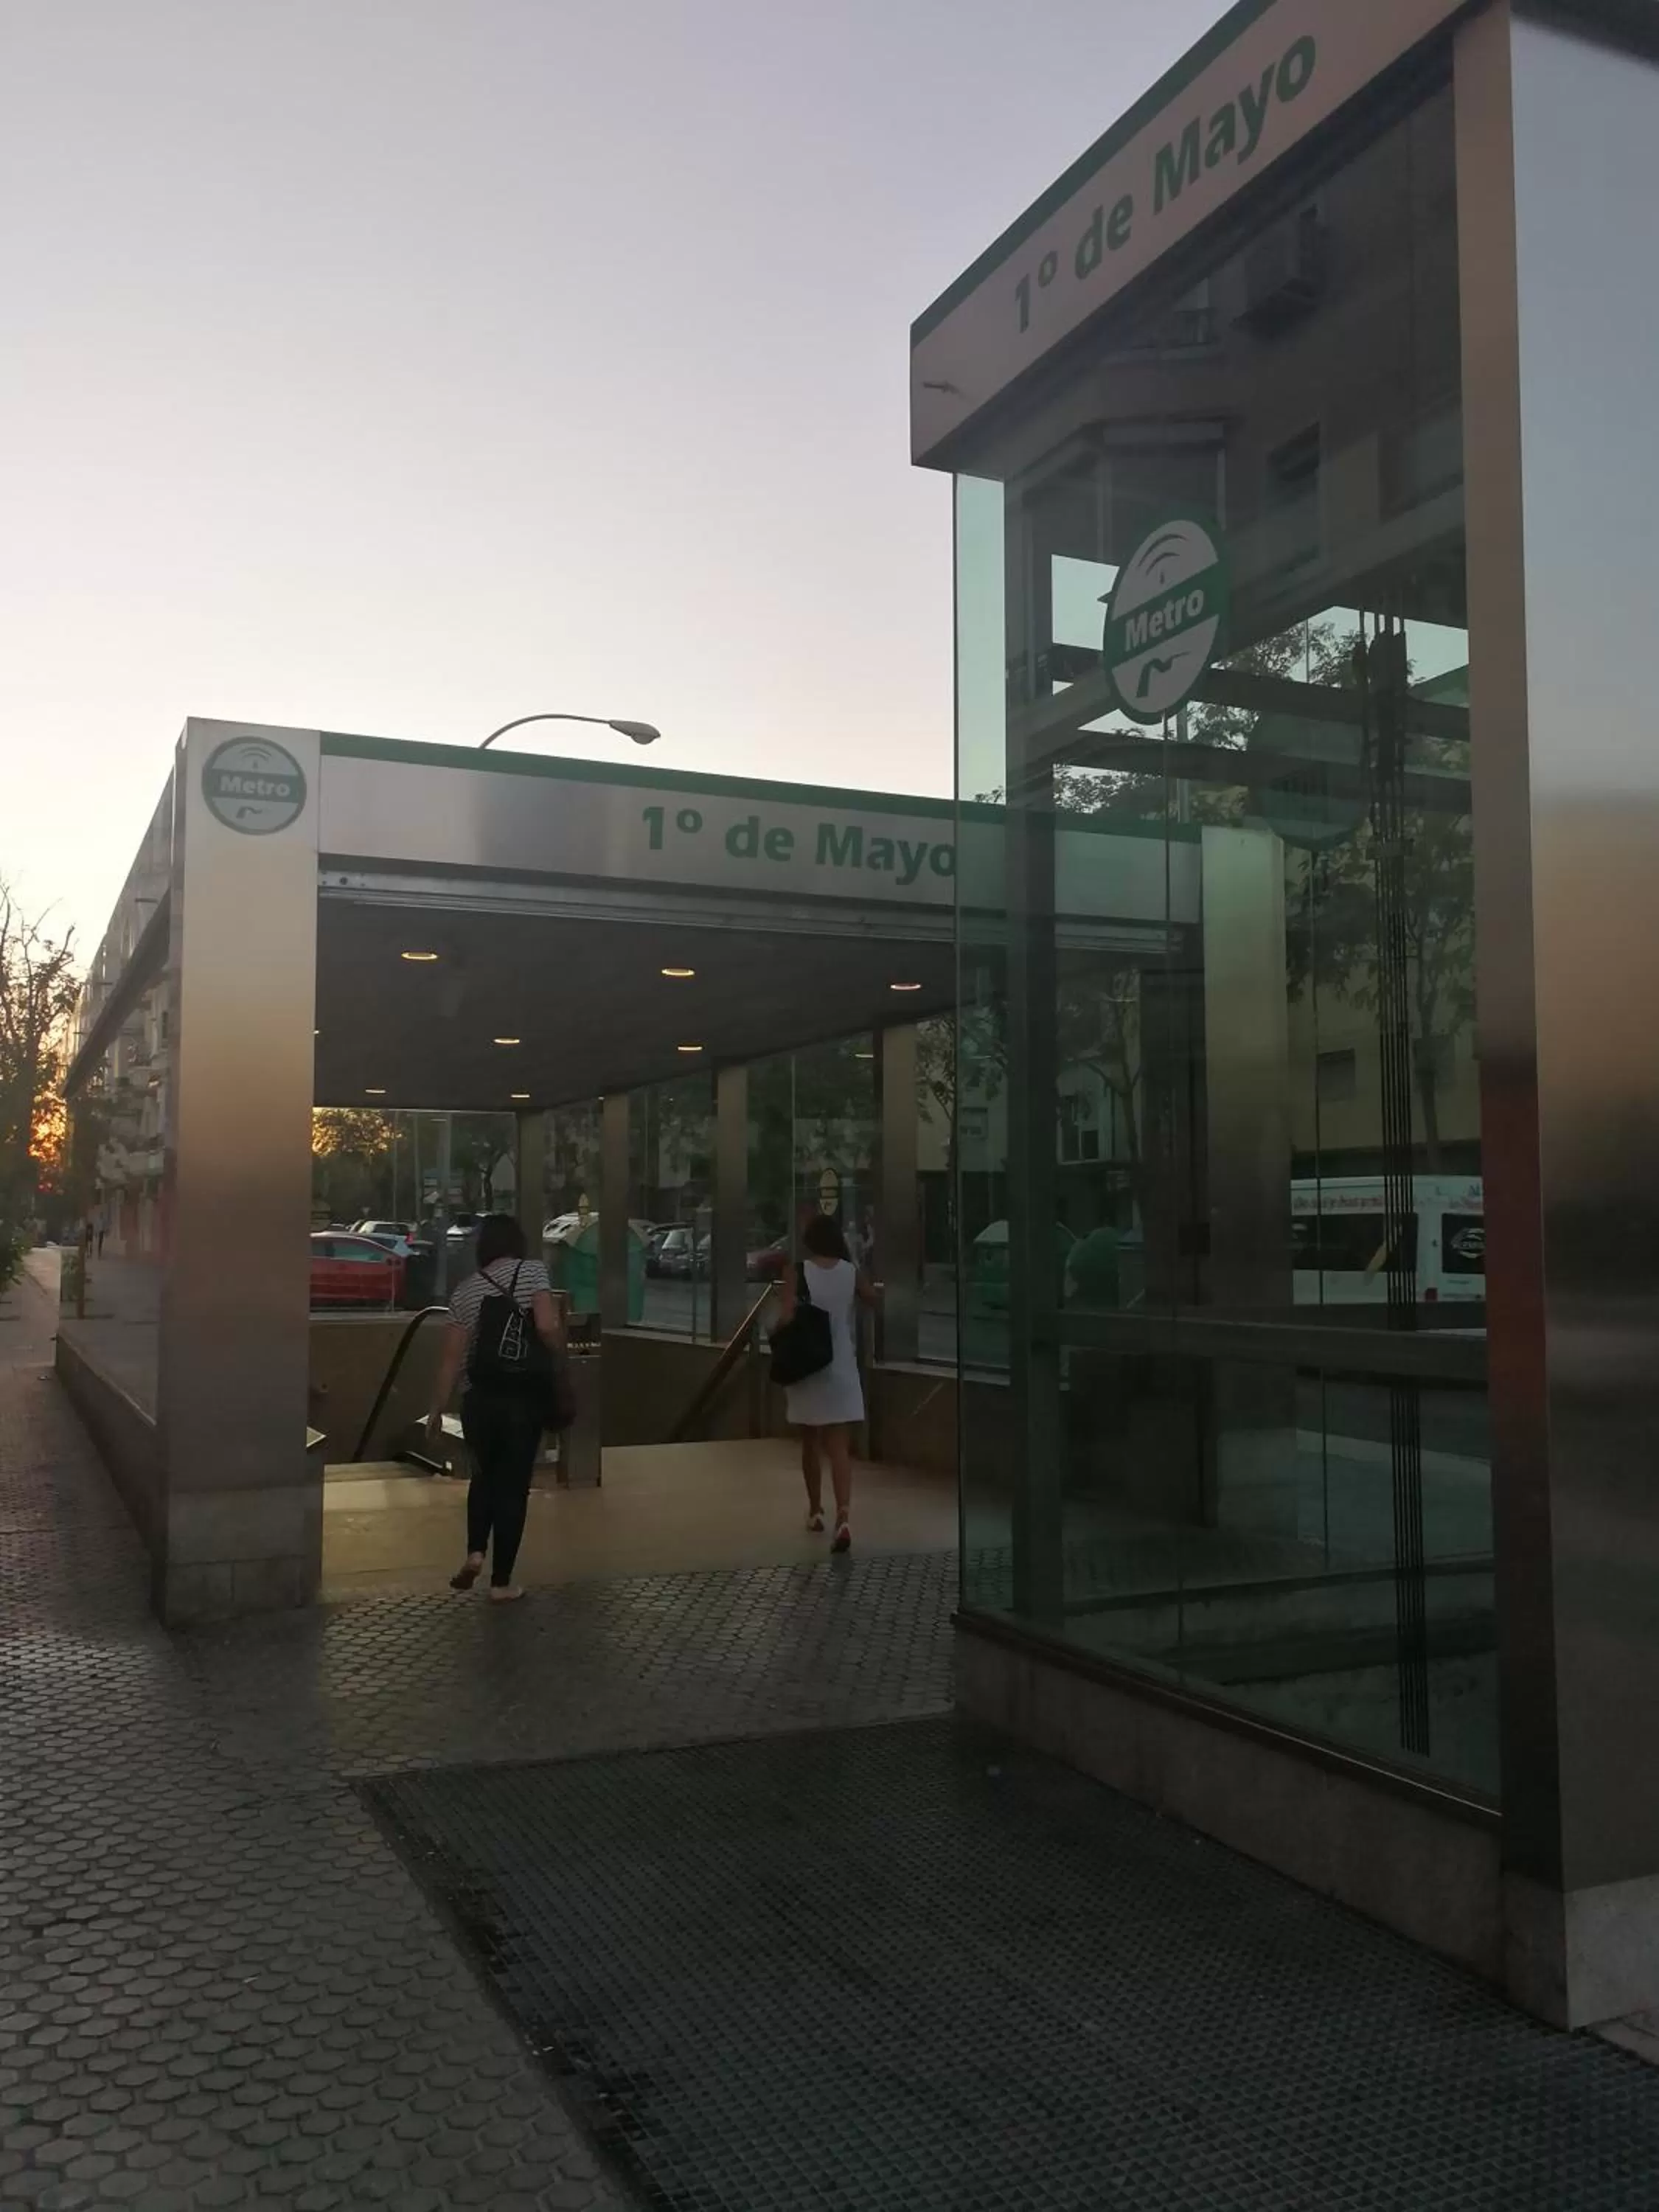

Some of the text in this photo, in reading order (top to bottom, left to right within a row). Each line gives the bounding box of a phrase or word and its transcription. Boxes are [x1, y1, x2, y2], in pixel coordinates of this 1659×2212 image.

[1074, 193, 1133, 281] de
[1152, 35, 1316, 216] Mayo
[1124, 589, 1205, 653] Metro
[220, 776, 291, 797] Metro
[725, 815, 795, 862] de
[815, 823, 956, 885] Mayo
